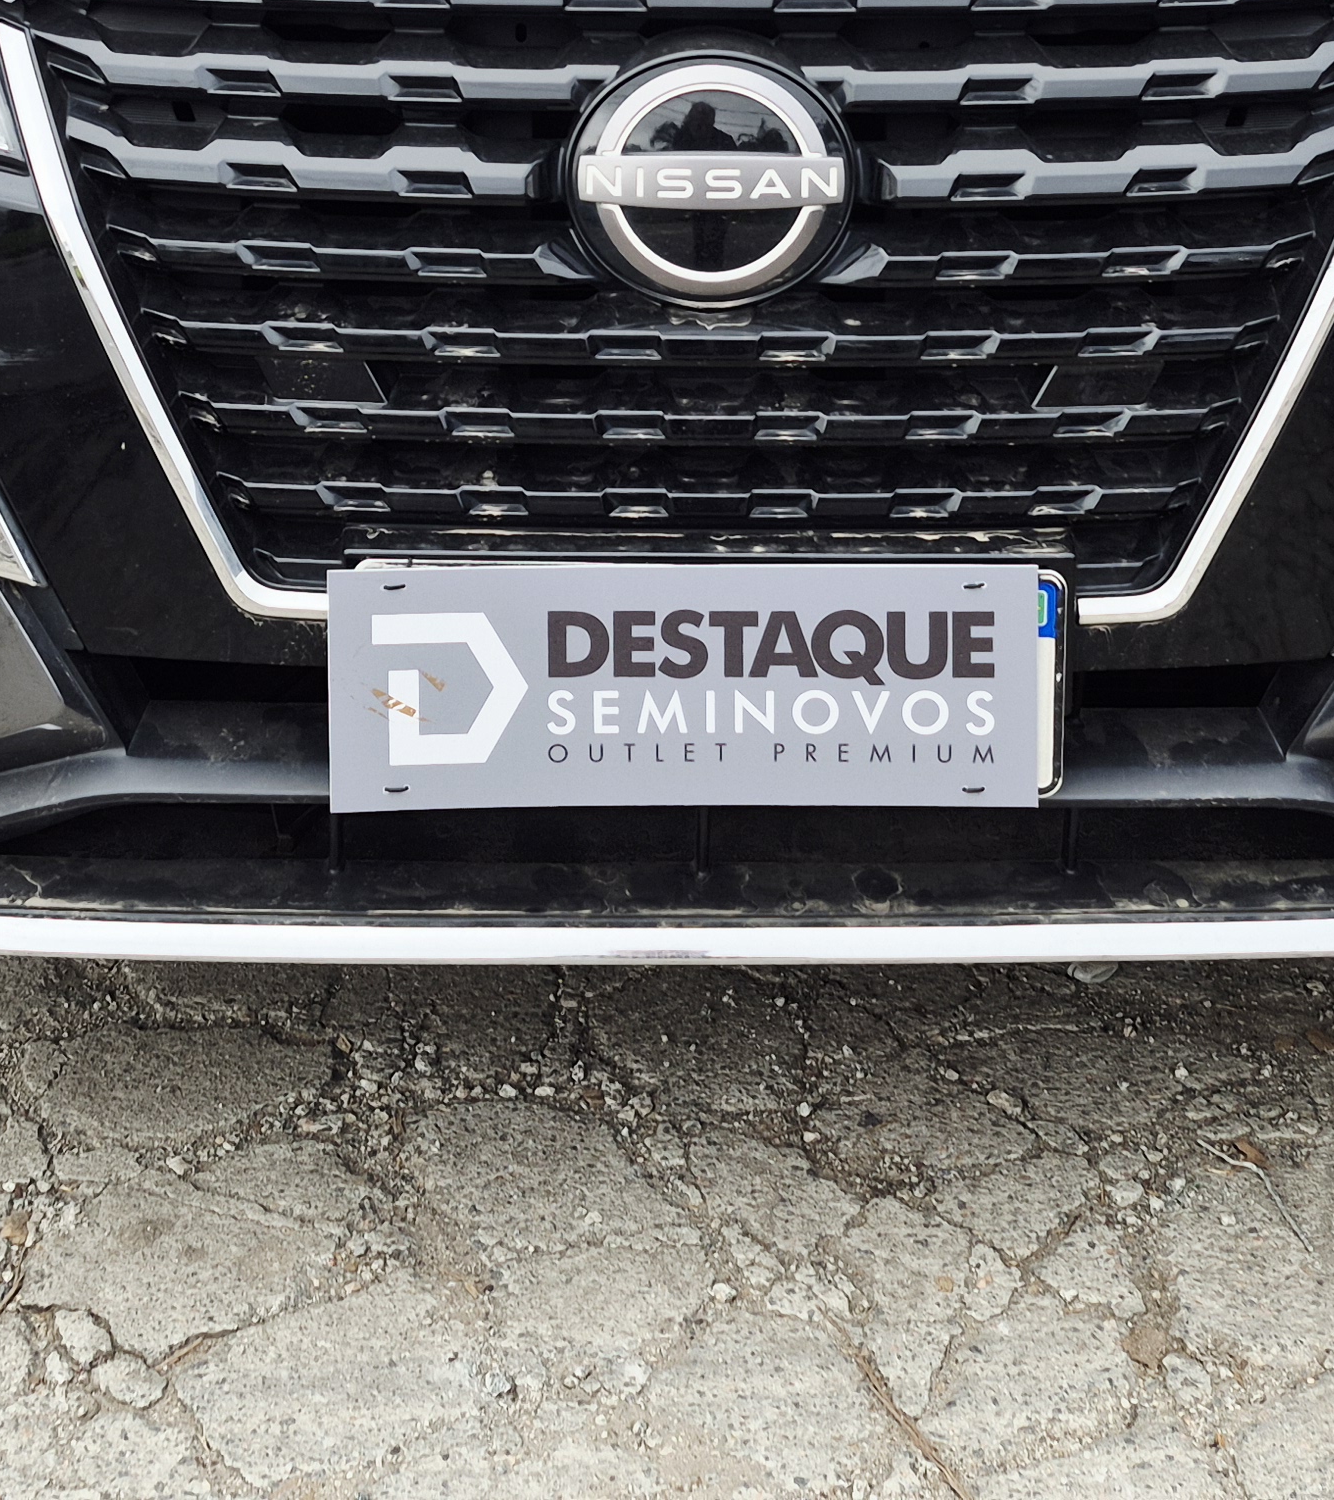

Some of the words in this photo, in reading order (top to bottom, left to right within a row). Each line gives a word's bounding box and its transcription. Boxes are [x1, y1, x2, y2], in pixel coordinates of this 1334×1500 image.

[585, 164, 839, 199] NISSAN
[547, 609, 996, 687] DESTAQUE
[547, 689, 996, 736] SEMINOVOS
[547, 742, 728, 765] OUTLET
[774, 742, 997, 765] PREMIUM
